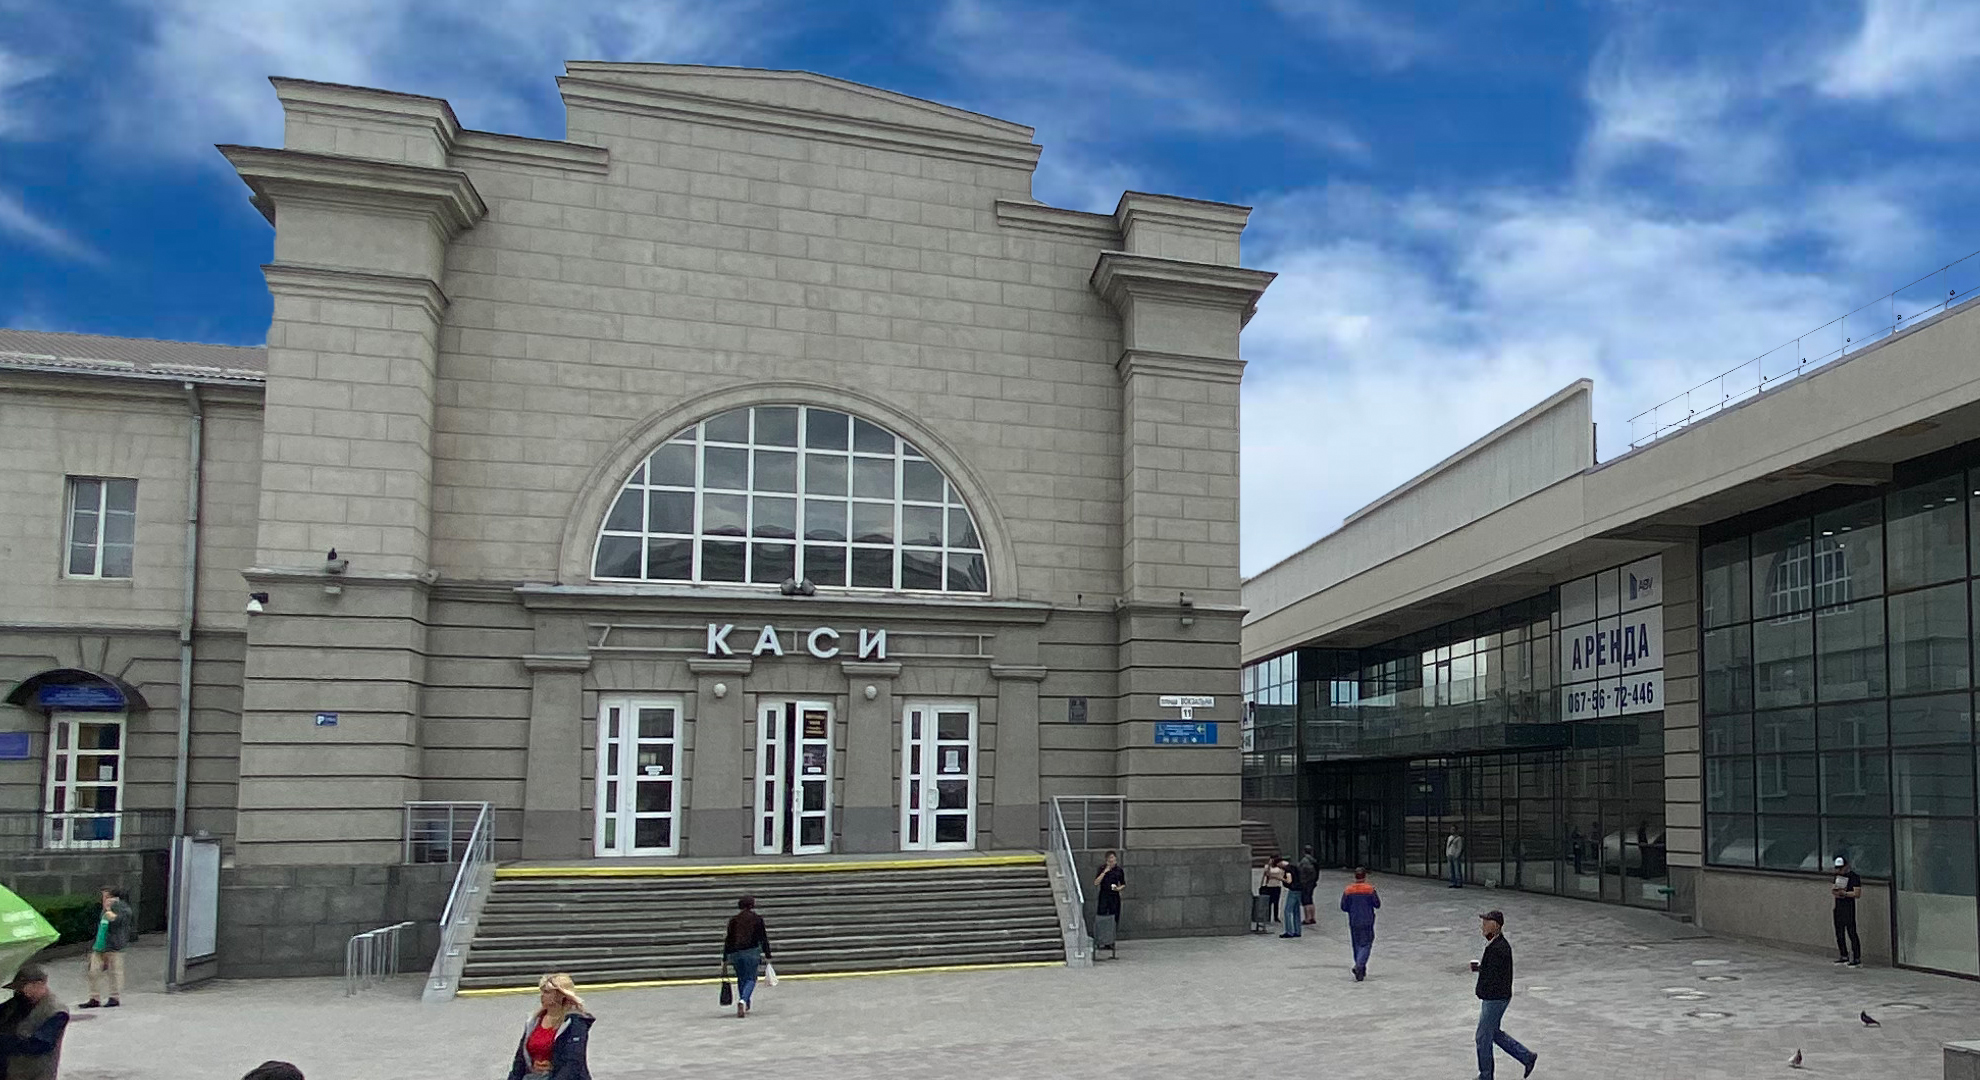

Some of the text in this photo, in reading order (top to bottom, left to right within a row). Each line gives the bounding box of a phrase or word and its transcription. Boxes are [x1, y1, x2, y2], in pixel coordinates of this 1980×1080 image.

[707, 623, 887, 660] КАСИ
[1572, 623, 1649, 670] АРЕНДА
[1183, 709, 1192, 717] 11
